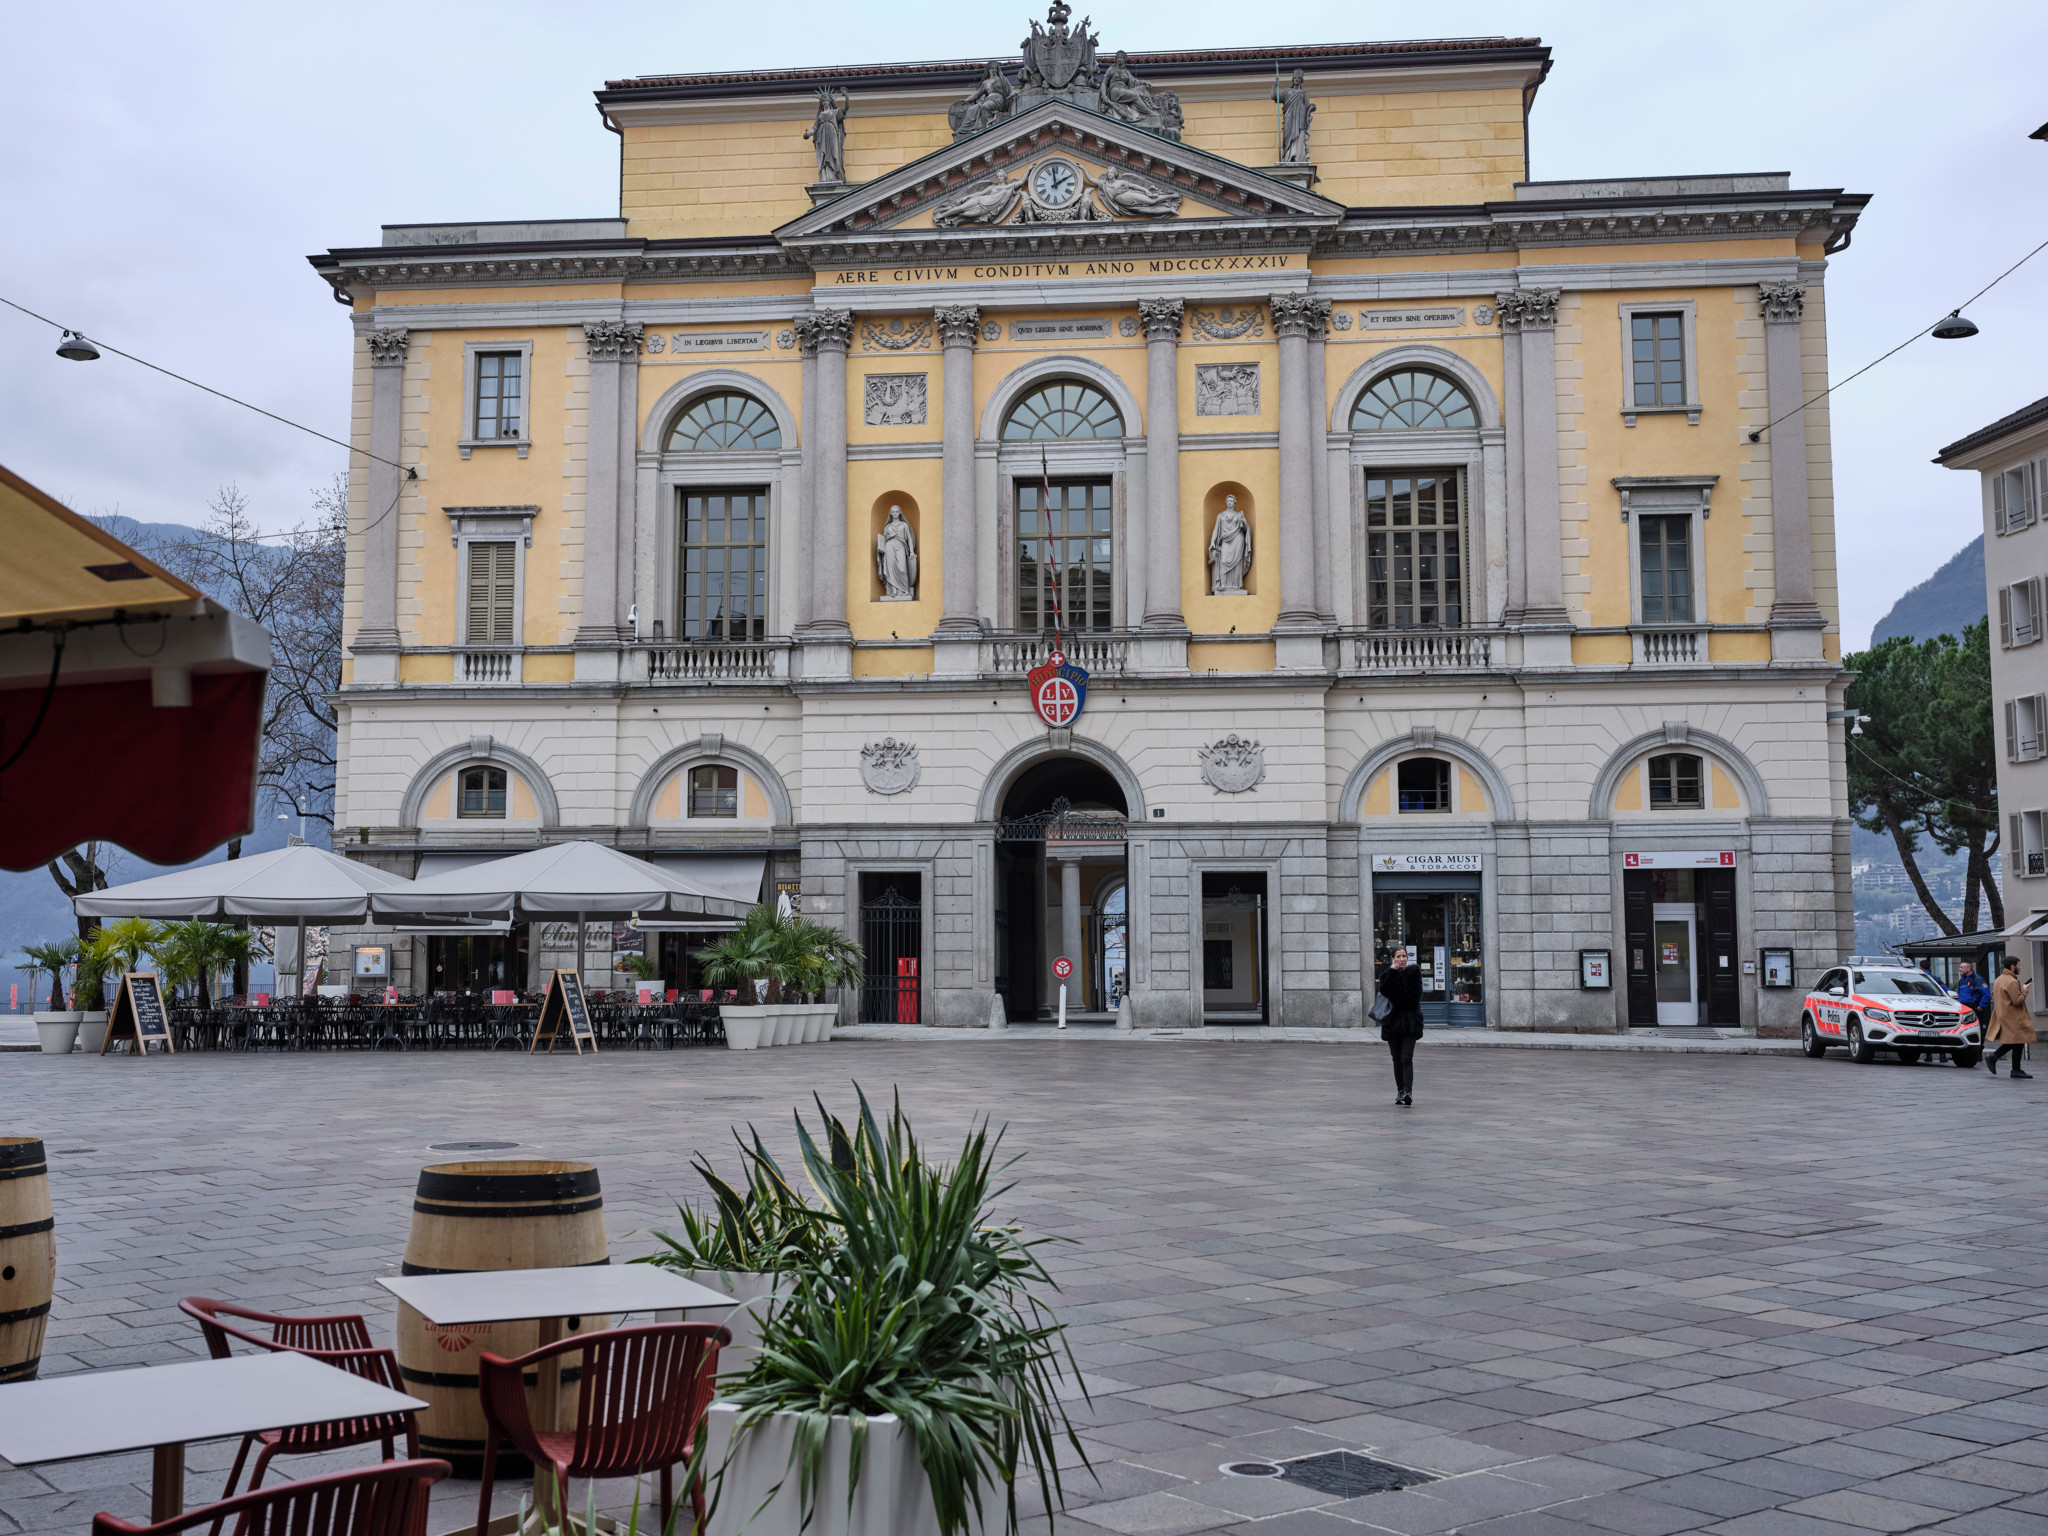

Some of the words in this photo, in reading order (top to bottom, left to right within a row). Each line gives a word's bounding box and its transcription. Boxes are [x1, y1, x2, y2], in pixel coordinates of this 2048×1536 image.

[836, 271, 879, 284] AERE
[893, 268, 958, 281] CIVIVM
[974, 265, 1070, 278] CONDITVM
[1085, 262, 1135, 274] ANNO
[1149, 256, 1288, 272] MDCCCXXXXIV
[1017, 327, 1033, 335] QVID
[1031, 667, 1087, 688] MUNICIPIO
[1045, 689, 1055, 699] L
[1061, 689, 1071, 698] V
[1045, 705, 1055, 715] G
[1061, 705, 1071, 715] A
[1406, 855, 1442, 864] CIGAR
[1447, 855, 1479, 863] MUST
[1879, 997, 1953, 1007] Polizia
[1827, 1010, 1841, 1023] Polizia
